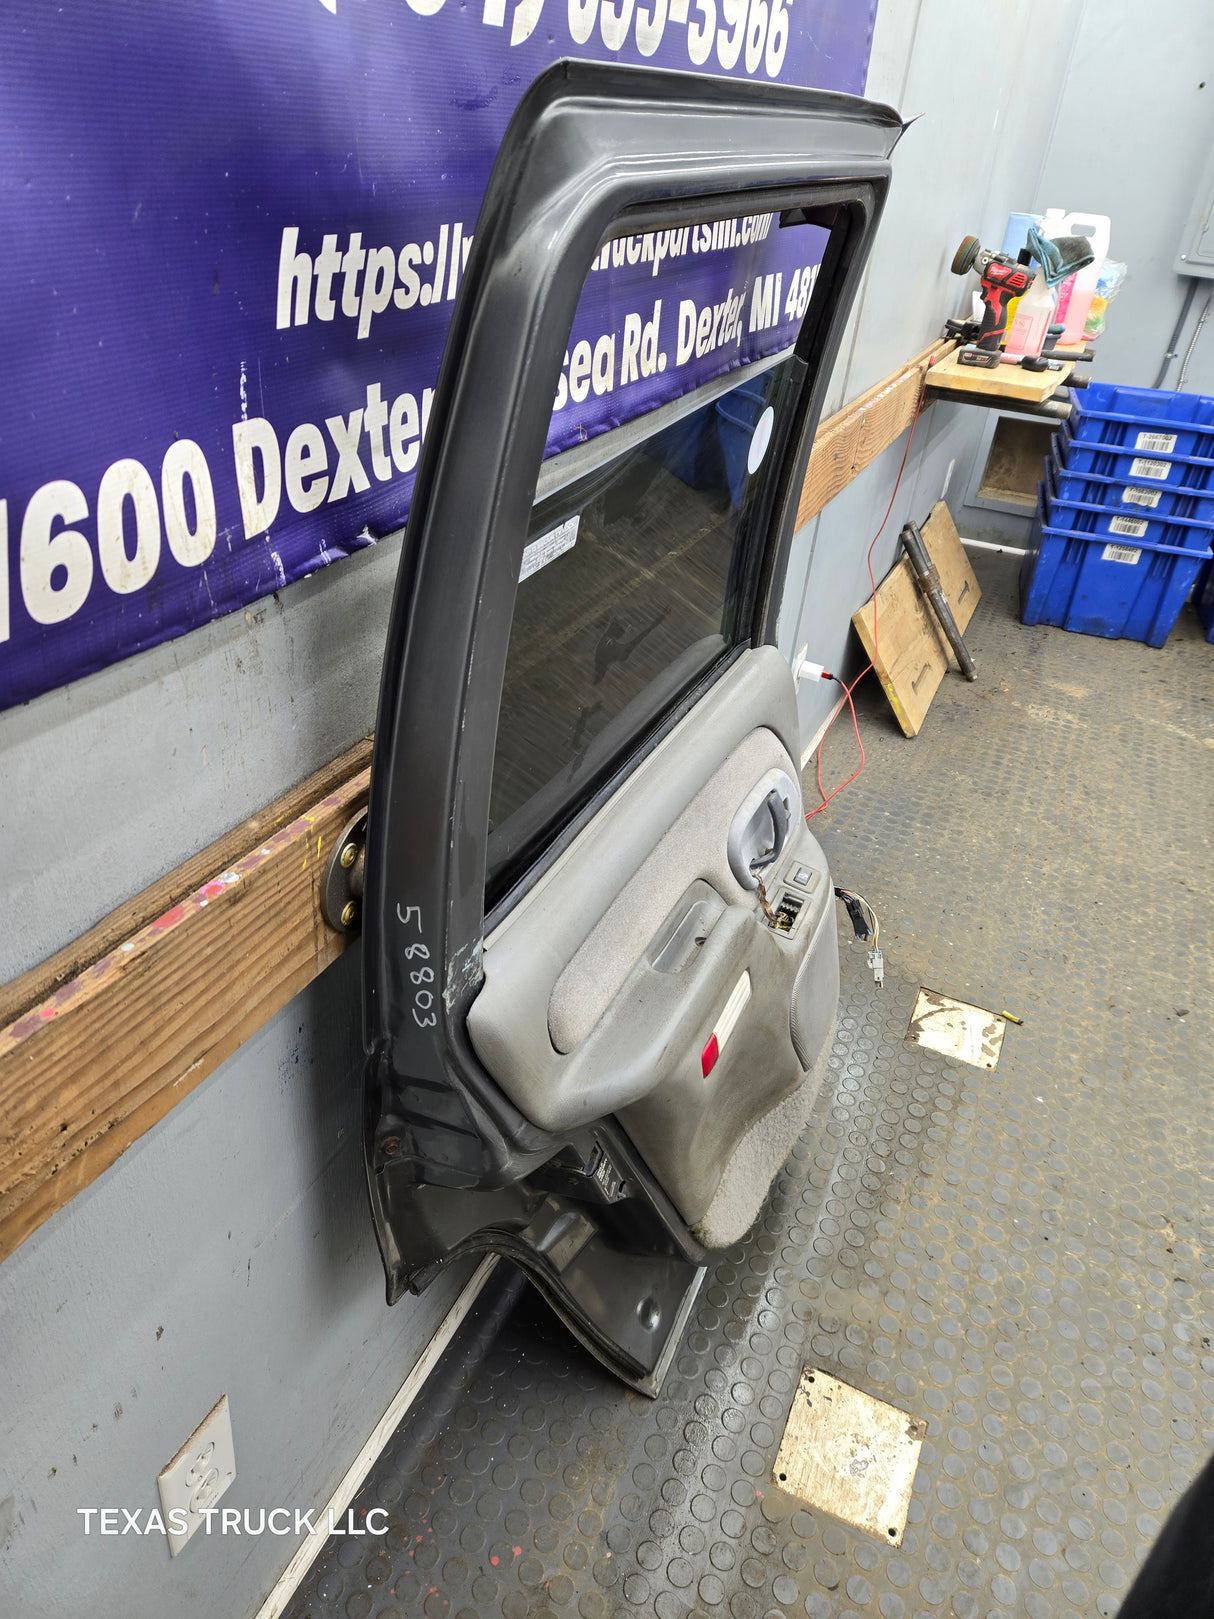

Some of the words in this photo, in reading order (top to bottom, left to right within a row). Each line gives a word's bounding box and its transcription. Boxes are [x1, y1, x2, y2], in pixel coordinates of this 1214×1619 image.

[620, 299, 667, 386] Rd.
[676, 289, 747, 367] Dexter,
[749, 272, 783, 333] MI
[785, 263, 821, 322] 481
[396, 902, 437, 1028] 58803
